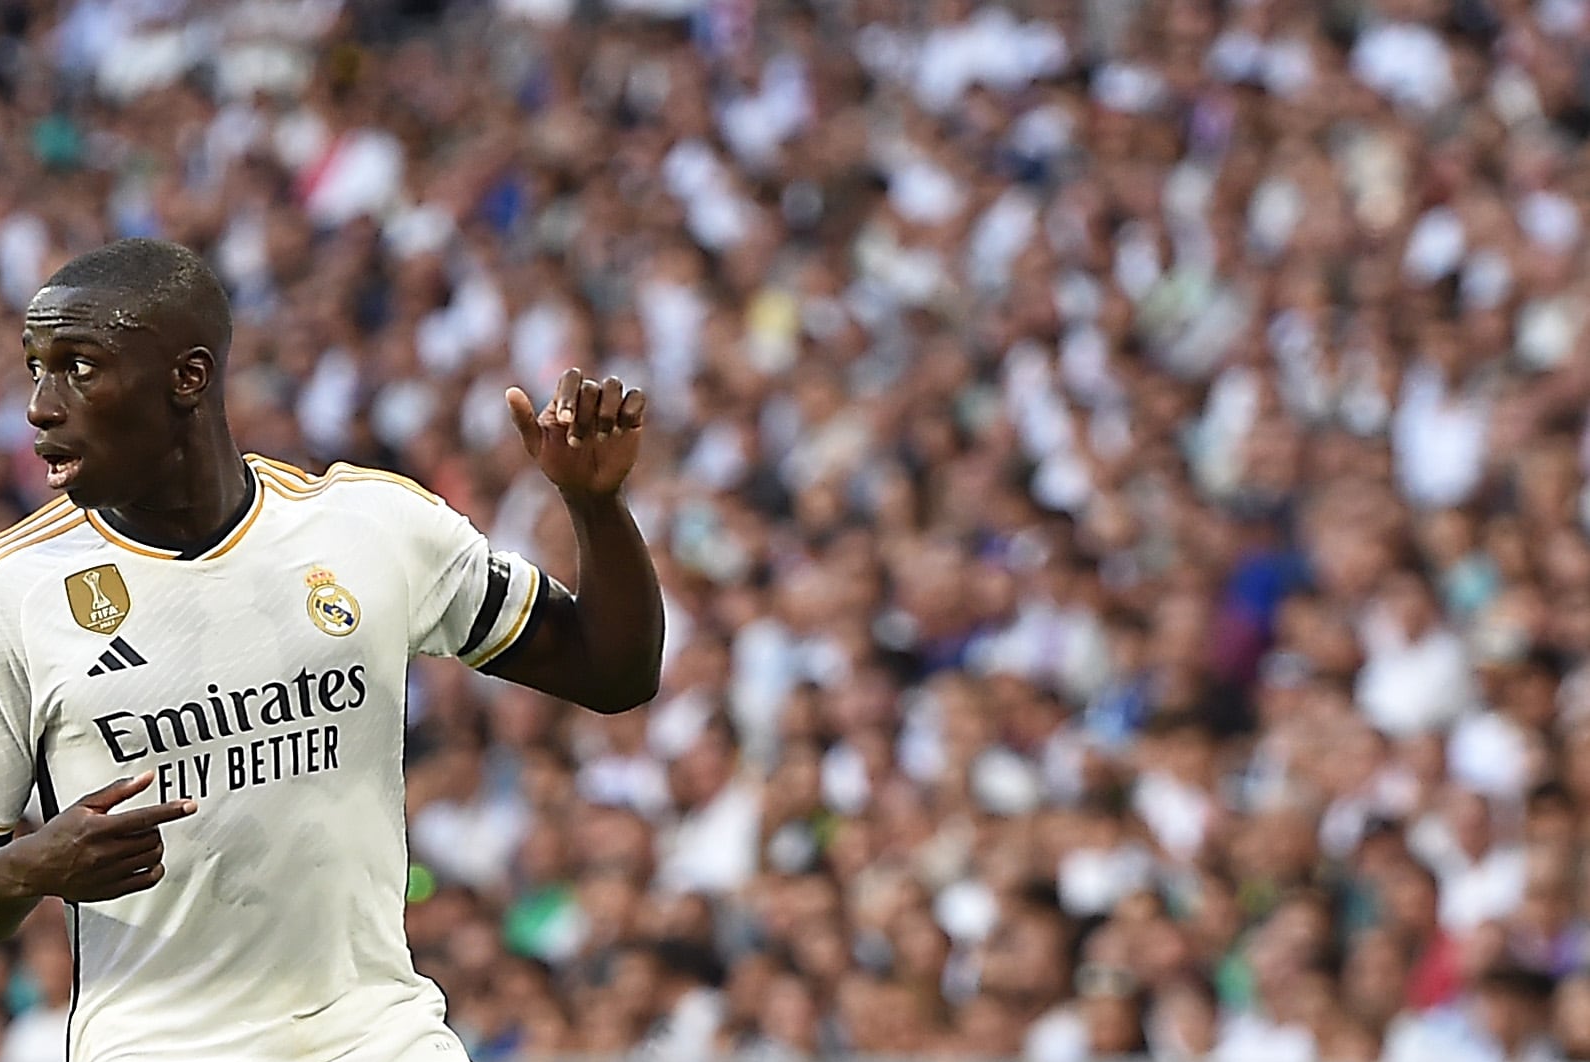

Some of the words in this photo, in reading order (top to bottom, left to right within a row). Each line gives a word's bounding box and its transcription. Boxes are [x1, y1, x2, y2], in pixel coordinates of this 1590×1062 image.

[90, 605, 118, 622] FIFA
[93, 664, 366, 763] Emirates
[158, 753, 211, 804] FLY
[228, 725, 339, 791] BETTER
